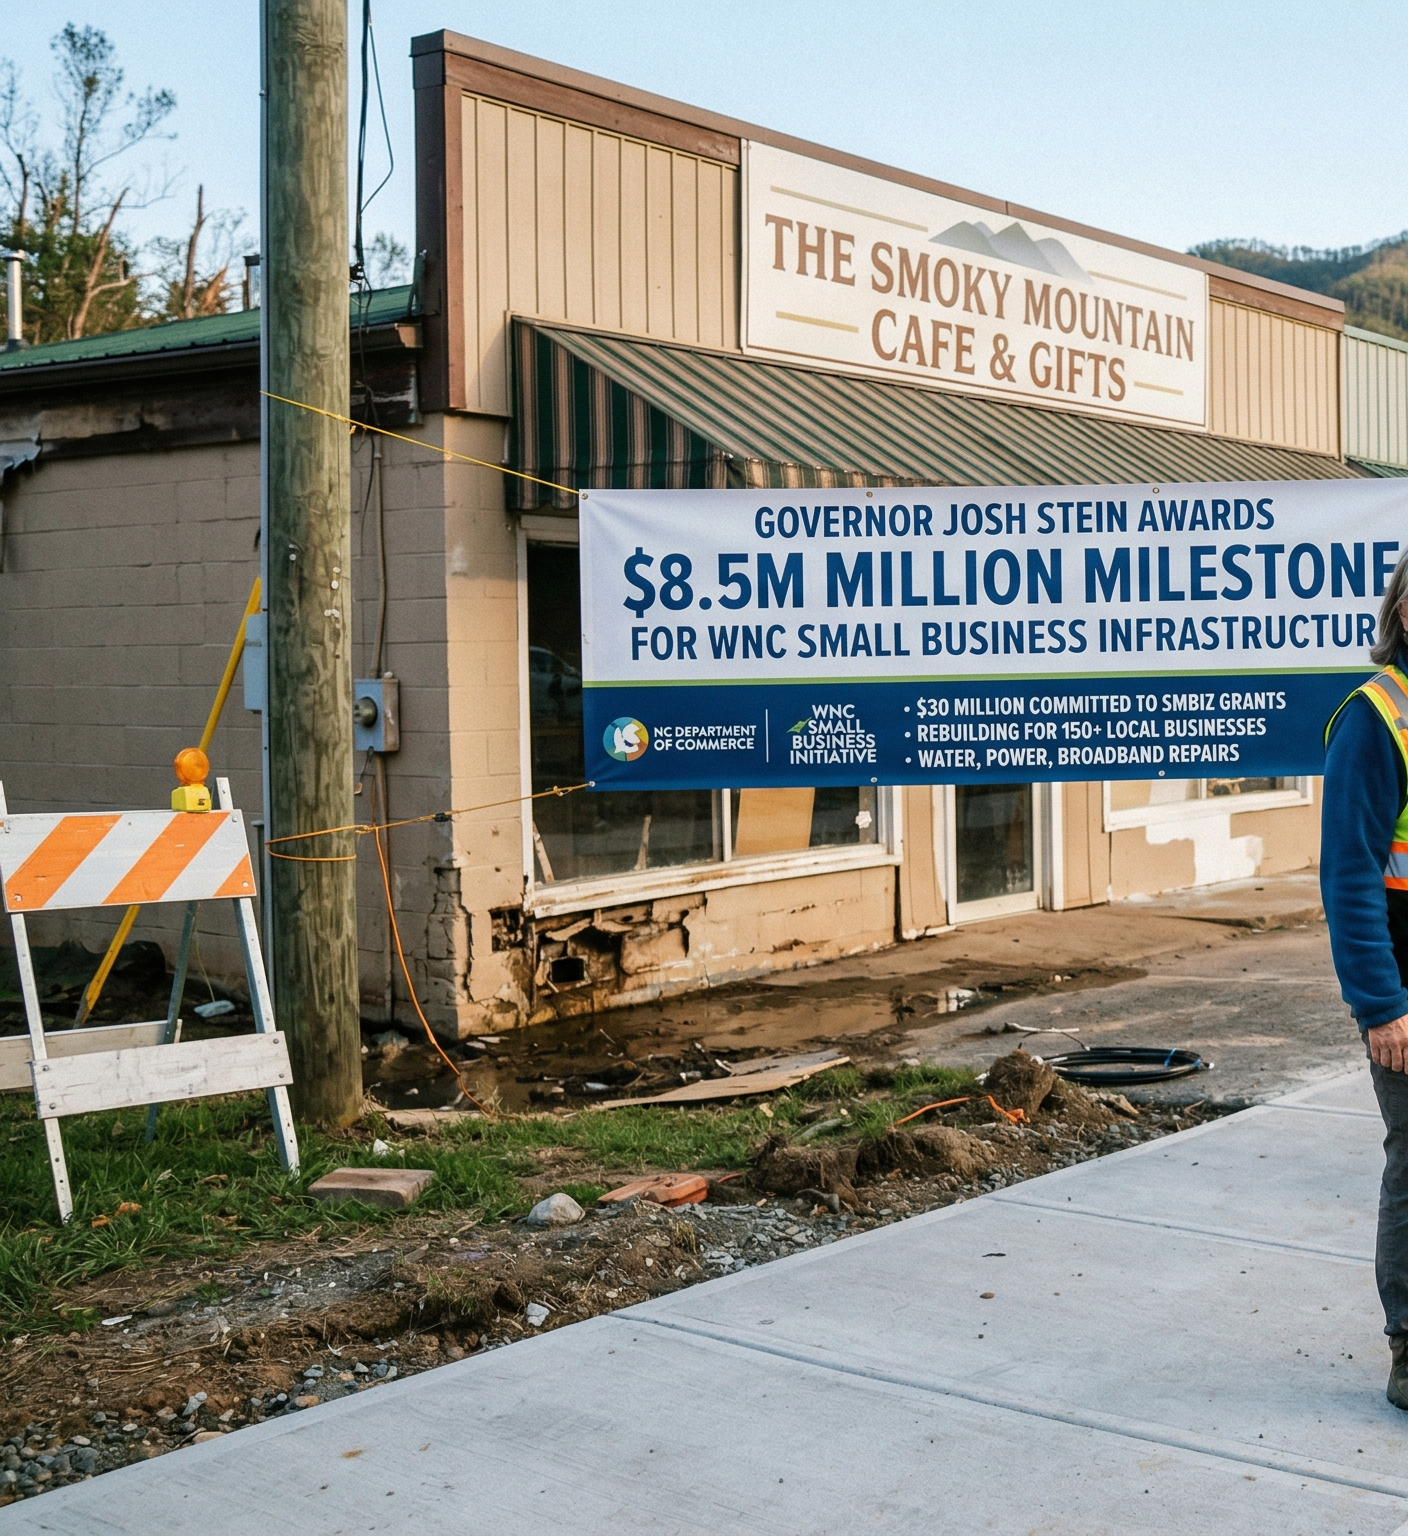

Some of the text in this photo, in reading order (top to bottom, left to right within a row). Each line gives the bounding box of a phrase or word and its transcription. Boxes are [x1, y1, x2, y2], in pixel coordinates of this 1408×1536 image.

[765, 214, 1194, 363] THE SMOKY MOUNTAIN
[872, 308, 1126, 402] CAFE & GIFTS
[755, 498, 1274, 538] GOVERNOR JOSH STEIN AWARDS
[623, 541, 1399, 618] $8.5M MILLION MILESTONE
[632, 613, 1376, 660] FOR WNC SMALL BUSINESS INFRASTRUCTUR
[812, 704, 855, 719] WNC
[917, 692, 1286, 718] $30 MILLION COMMITTED TO SMBIZ GRANTS
[654, 725, 756, 738] NC DEPARTMENT
[808, 719, 865, 734] SMALL
[918, 718, 1266, 741] REBUILDING FOR 150+ LOCAL BUSINESSES
[654, 738, 754, 751] OF COMMERCE
[793, 733, 875, 749] BUSINESS
[790, 748, 876, 764] INITIATIVE
[918, 744, 1239, 770] WATER, POWER, BROADBAND REPAIRS
